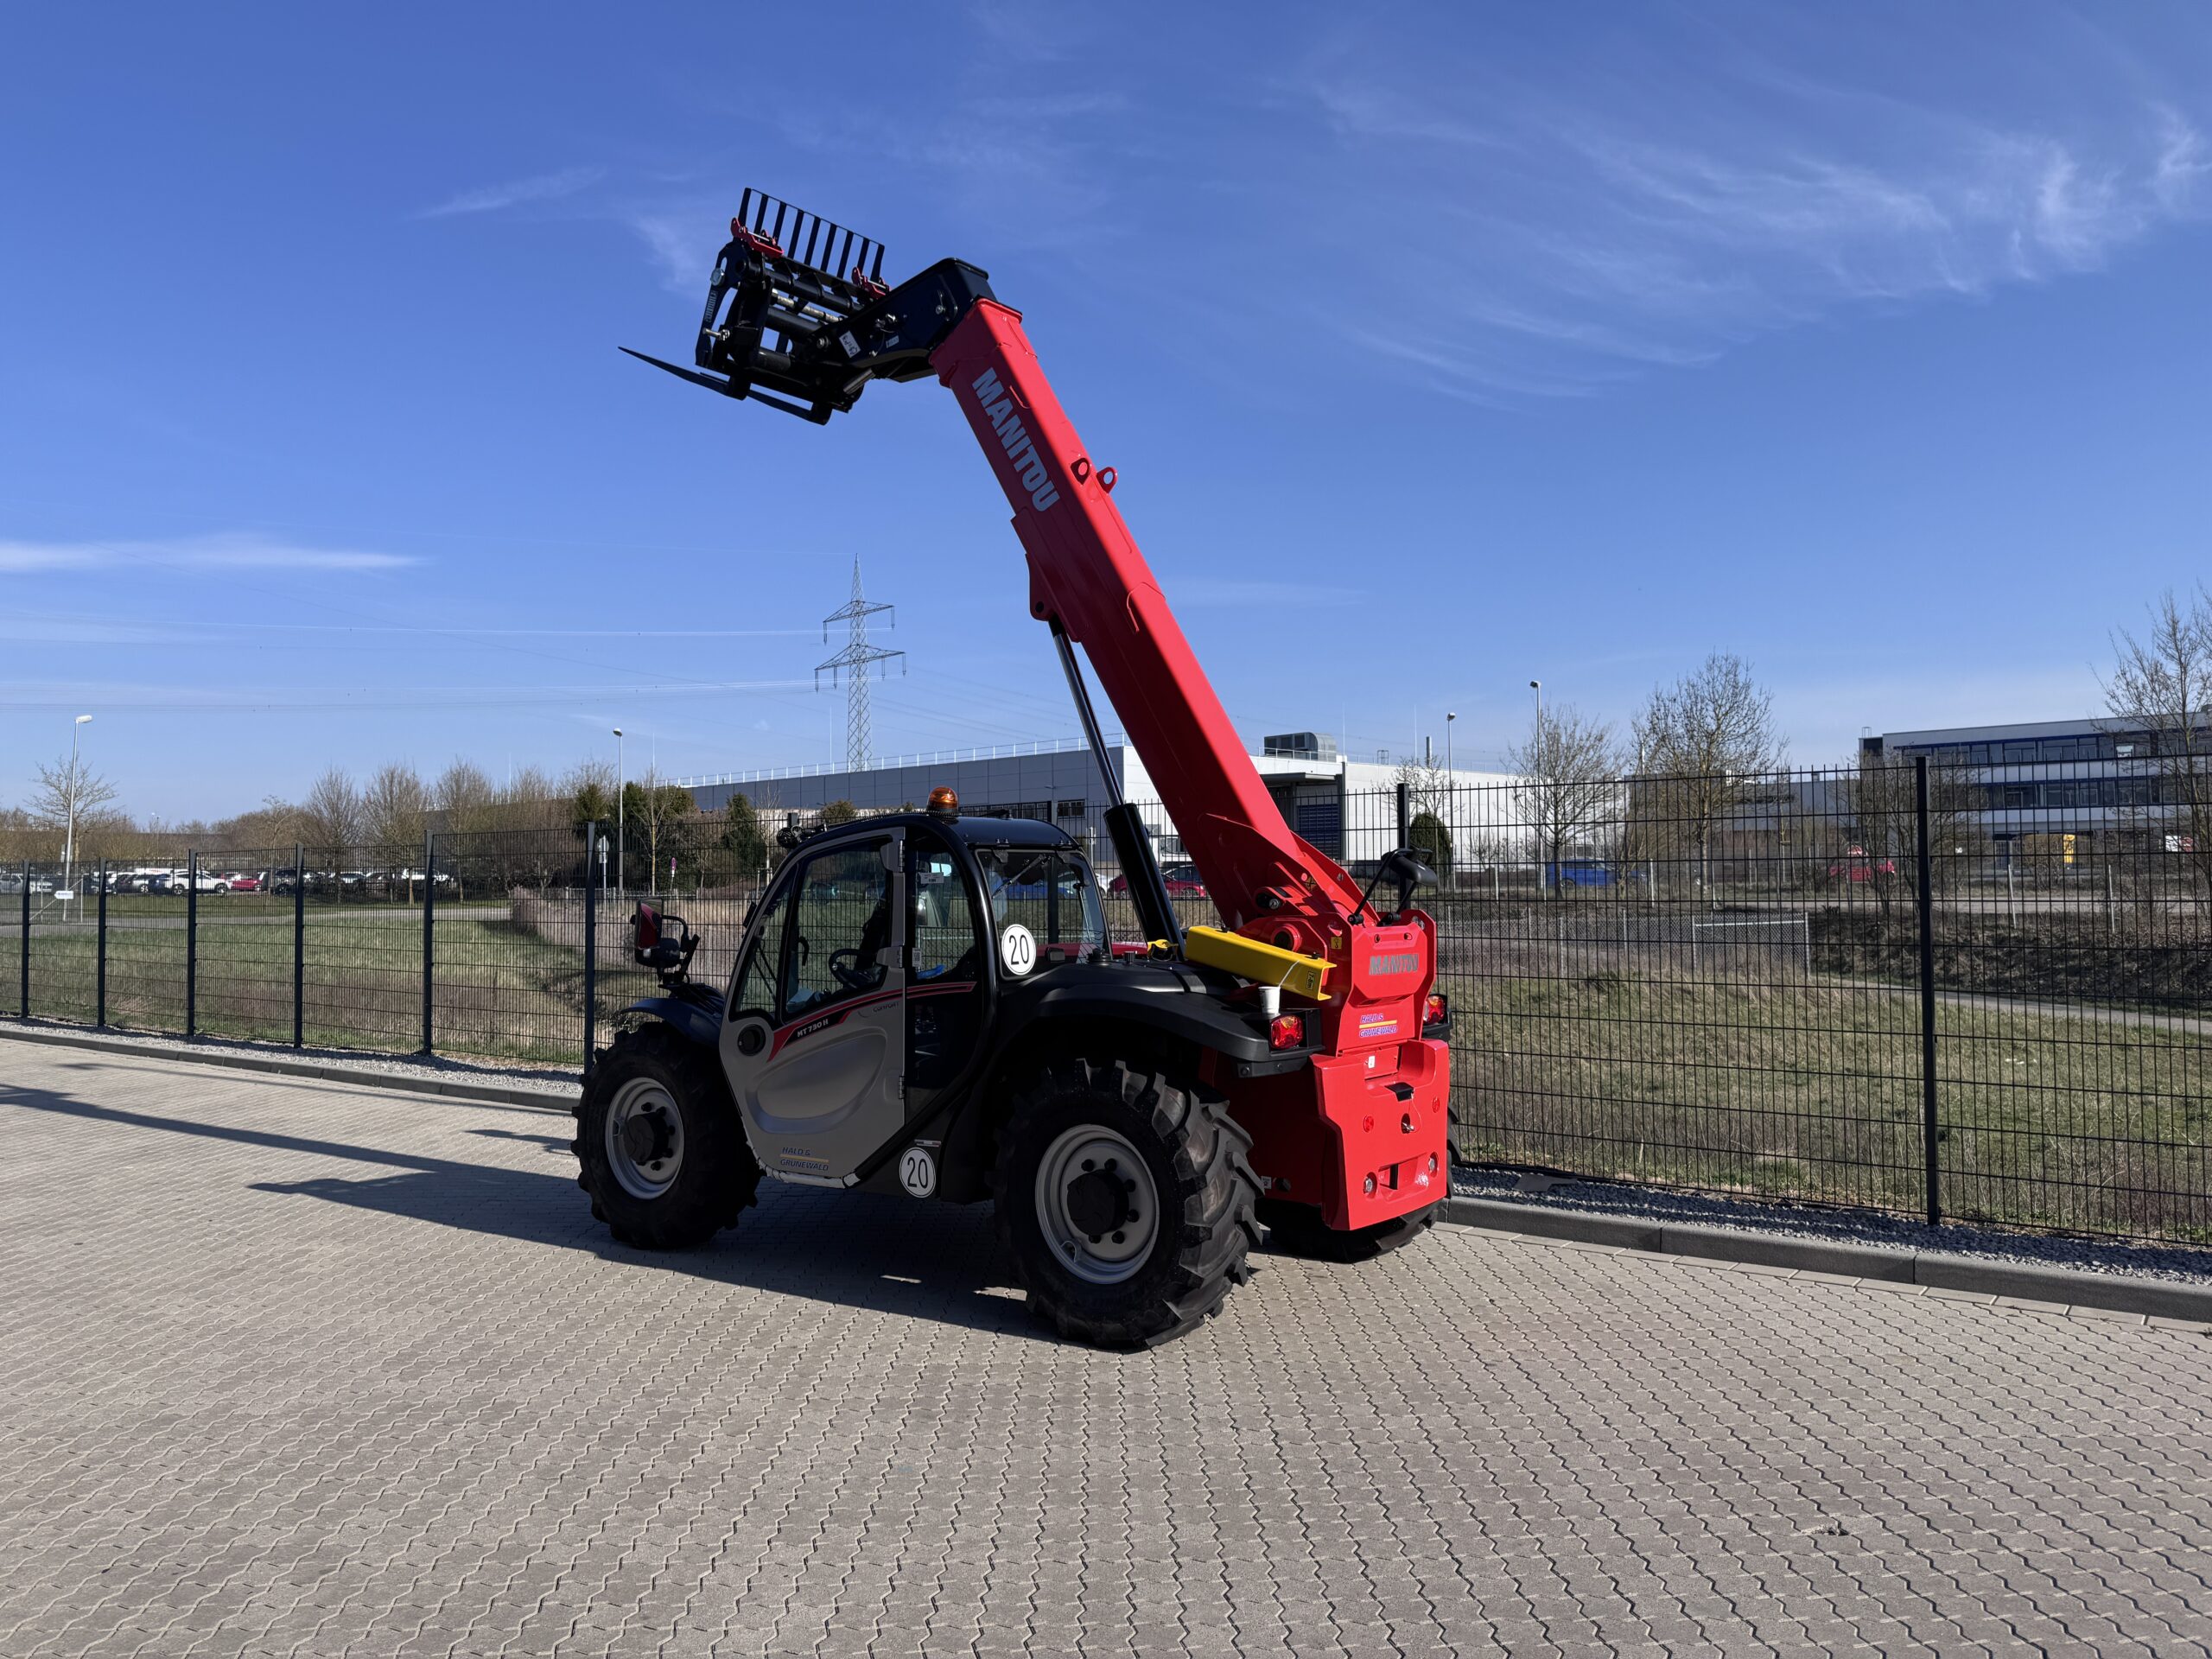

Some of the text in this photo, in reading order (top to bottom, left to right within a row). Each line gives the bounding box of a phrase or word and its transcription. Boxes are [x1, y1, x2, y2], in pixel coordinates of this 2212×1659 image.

[972, 367, 1060, 512] MANITOU
[1008, 934, 1030, 965] 20
[1369, 954, 1419, 976] MANITOU
[1360, 1013, 1383, 1023] HALD &
[808, 1021, 823, 1033] 730
[782, 1147, 804, 1155] HALD
[780, 1159, 829, 1171] GRUNEWALD
[907, 1156, 928, 1189] 20
